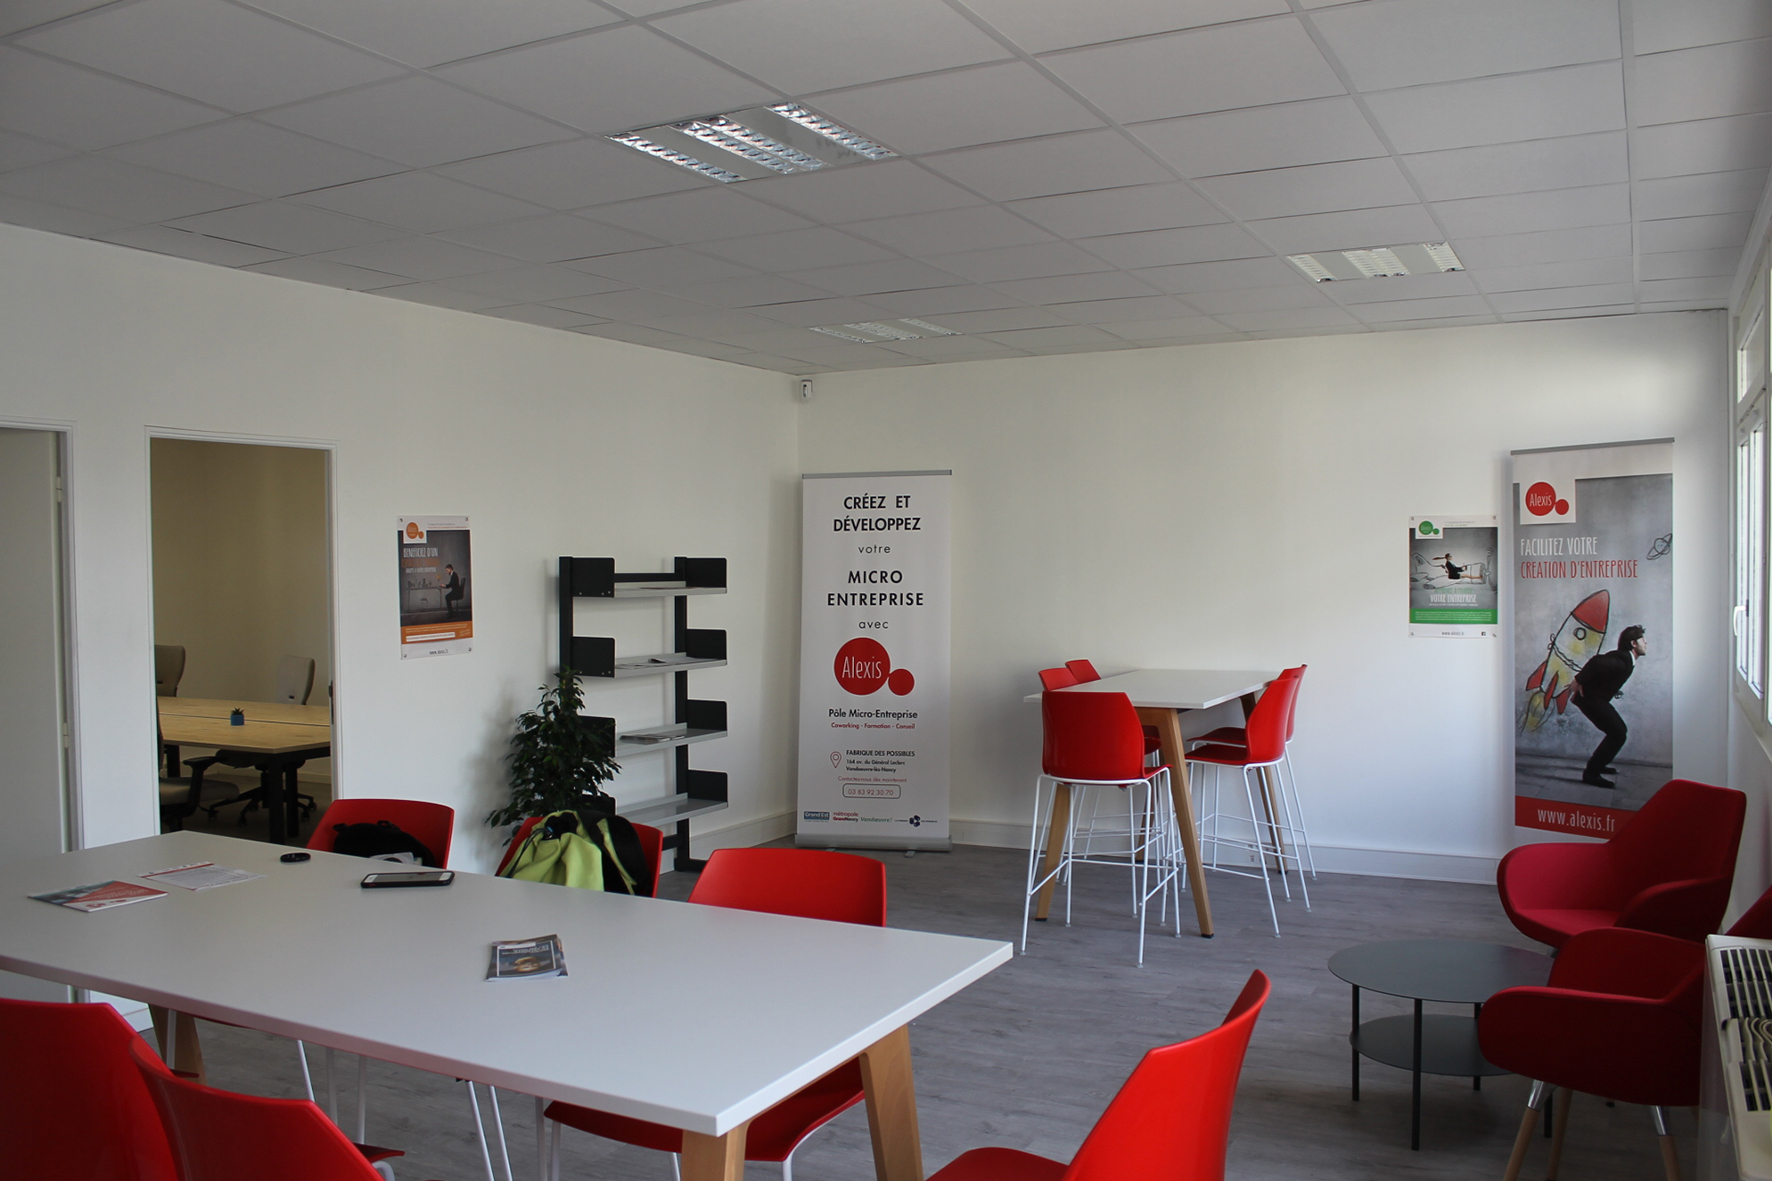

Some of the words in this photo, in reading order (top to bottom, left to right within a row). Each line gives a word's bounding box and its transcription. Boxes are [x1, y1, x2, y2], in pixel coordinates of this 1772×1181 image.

[843, 493, 886, 510] CRÉEZ
[896, 496, 911, 508] ET
[1529, 492, 1552, 507] Alexis
[833, 516, 921, 532] DÉVELOPPEZ
[858, 544, 891, 554] votre
[1520, 538, 1564, 556] FACILITEZ
[1567, 536, 1598, 555] VOTRE
[1520, 561, 1566, 578] CREATION
[1570, 560, 1638, 578] D'ENTREPRISE
[848, 570, 903, 584] MICRO
[827, 593, 924, 606] ENTREPRISE
[1430, 594, 1446, 603] VOTRE
[858, 621, 889, 629] avec
[842, 656, 882, 679] Alexis
[828, 708, 846, 718] Pôle
[848, 709, 918, 720] Micro-Entreprise
[1537, 809, 1616, 832] www.alexis.fr
